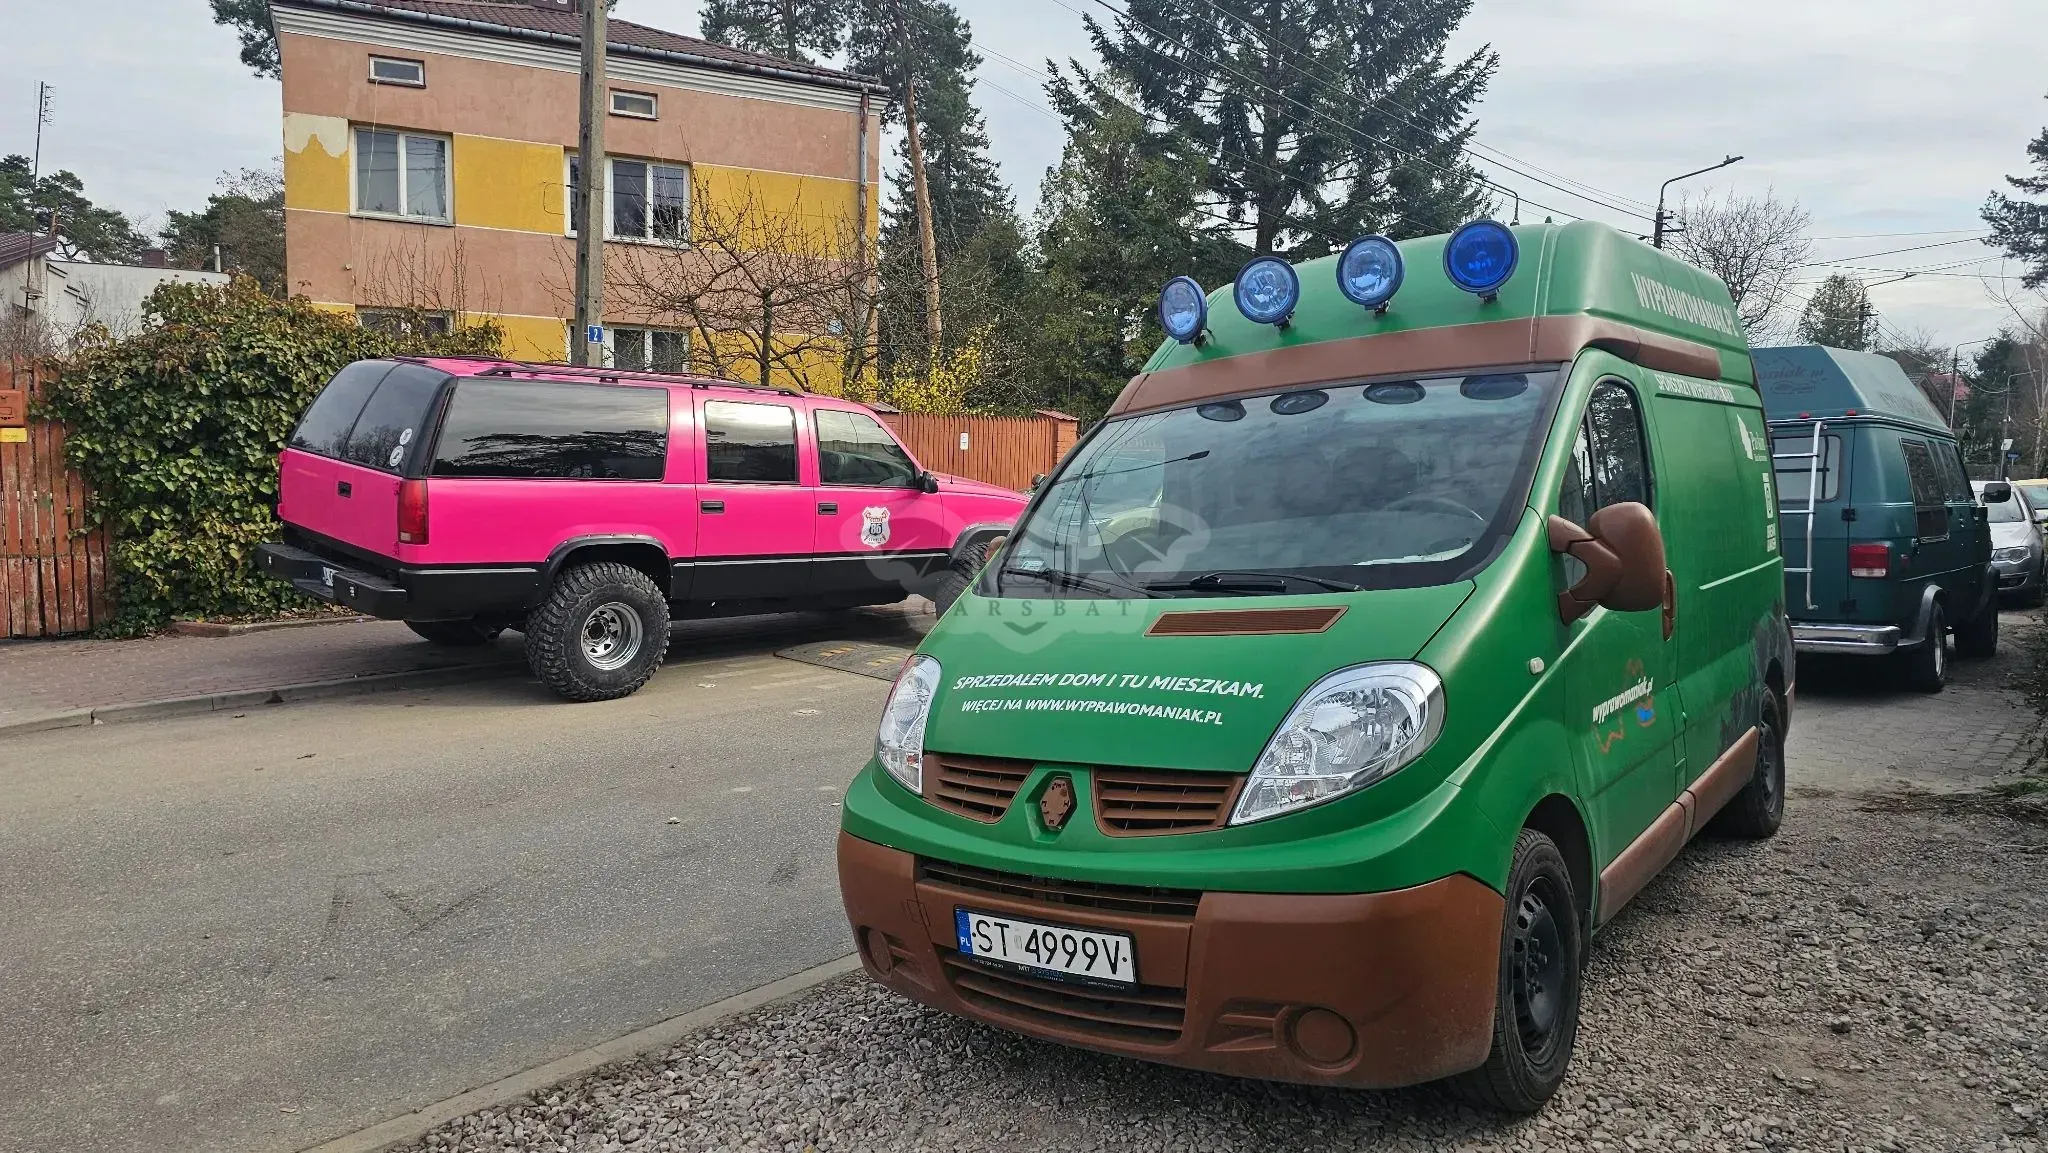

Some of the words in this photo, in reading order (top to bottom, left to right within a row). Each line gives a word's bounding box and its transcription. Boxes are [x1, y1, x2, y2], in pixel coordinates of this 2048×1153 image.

[1630, 271, 1740, 338] WYPRAWOMANIAK.PL
[593, 328, 599, 341] 2
[952, 673, 1059, 690] SPRZEDAŁEM
[1057, 673, 1108, 687] DOM
[1105, 673, 1118, 687] I
[1119, 674, 1148, 688] TU
[1148, 675, 1265, 699] MIESZKAM.
[961, 699, 1001, 714] WIĘCEJ
[1003, 699, 1022, 710] NA
[1024, 699, 1224, 725] WWW.WYPRAWOMANIAK.PL
[960, 936, 971, 946] PL
[974, 919, 1010, 957] ST
[1024, 928, 1120, 975] 4999V
